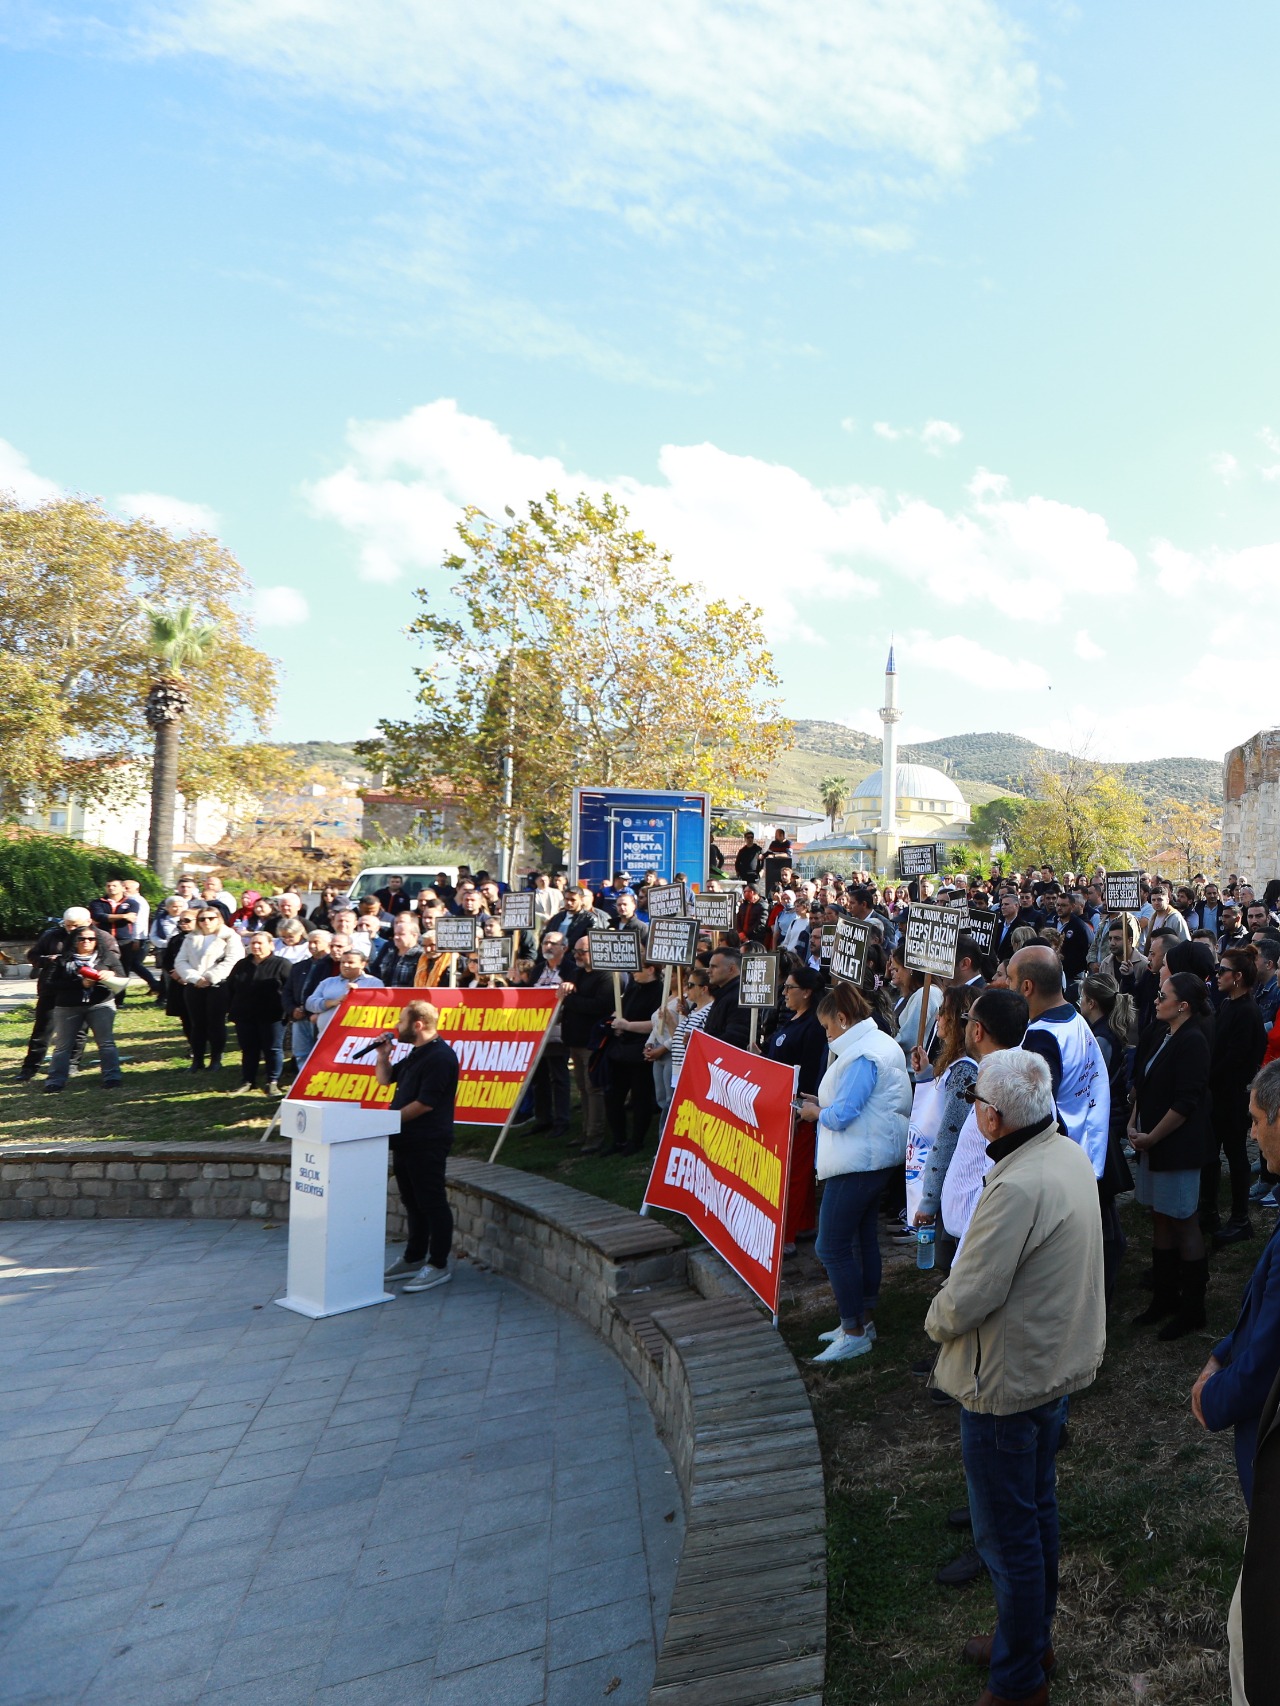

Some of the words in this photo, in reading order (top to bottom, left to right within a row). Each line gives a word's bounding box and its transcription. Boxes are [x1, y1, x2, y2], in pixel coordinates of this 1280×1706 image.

[623, 842, 662, 851] NOKTA
[904, 863, 931, 874] BİZİMDİR
[670, 890, 681, 900] ANA
[1108, 891, 1119, 899] EFES
[1120, 890, 1138, 899] SELÇUK
[696, 908, 709, 916] RANT
[942, 913, 958, 926] EMEK
[982, 921, 993, 930] EVİ
[459, 925, 472, 933] ANA
[853, 927, 865, 943] ANA
[908, 921, 932, 940] HEPSİ
[932, 924, 956, 945] BİZİM
[592, 941, 611, 952] HEPSİ
[613, 941, 635, 952] BİZİM
[906, 939, 927, 956] HEPSİ
[592, 952, 611, 961] HEPSİ
[652, 945, 687, 962] BIRAK!
[831, 950, 860, 980] ADALET
[745, 970, 767, 983] MABET
[744, 993, 766, 1004] MARKET!
[340, 1006, 404, 1029] MERYE
[482, 1007, 552, 1032] DOKUNMA
[299, 1167, 320, 1181] SELÇUK
[663, 1146, 697, 1195] EFES
[295, 1181, 324, 1197] BELEDİYESİ
